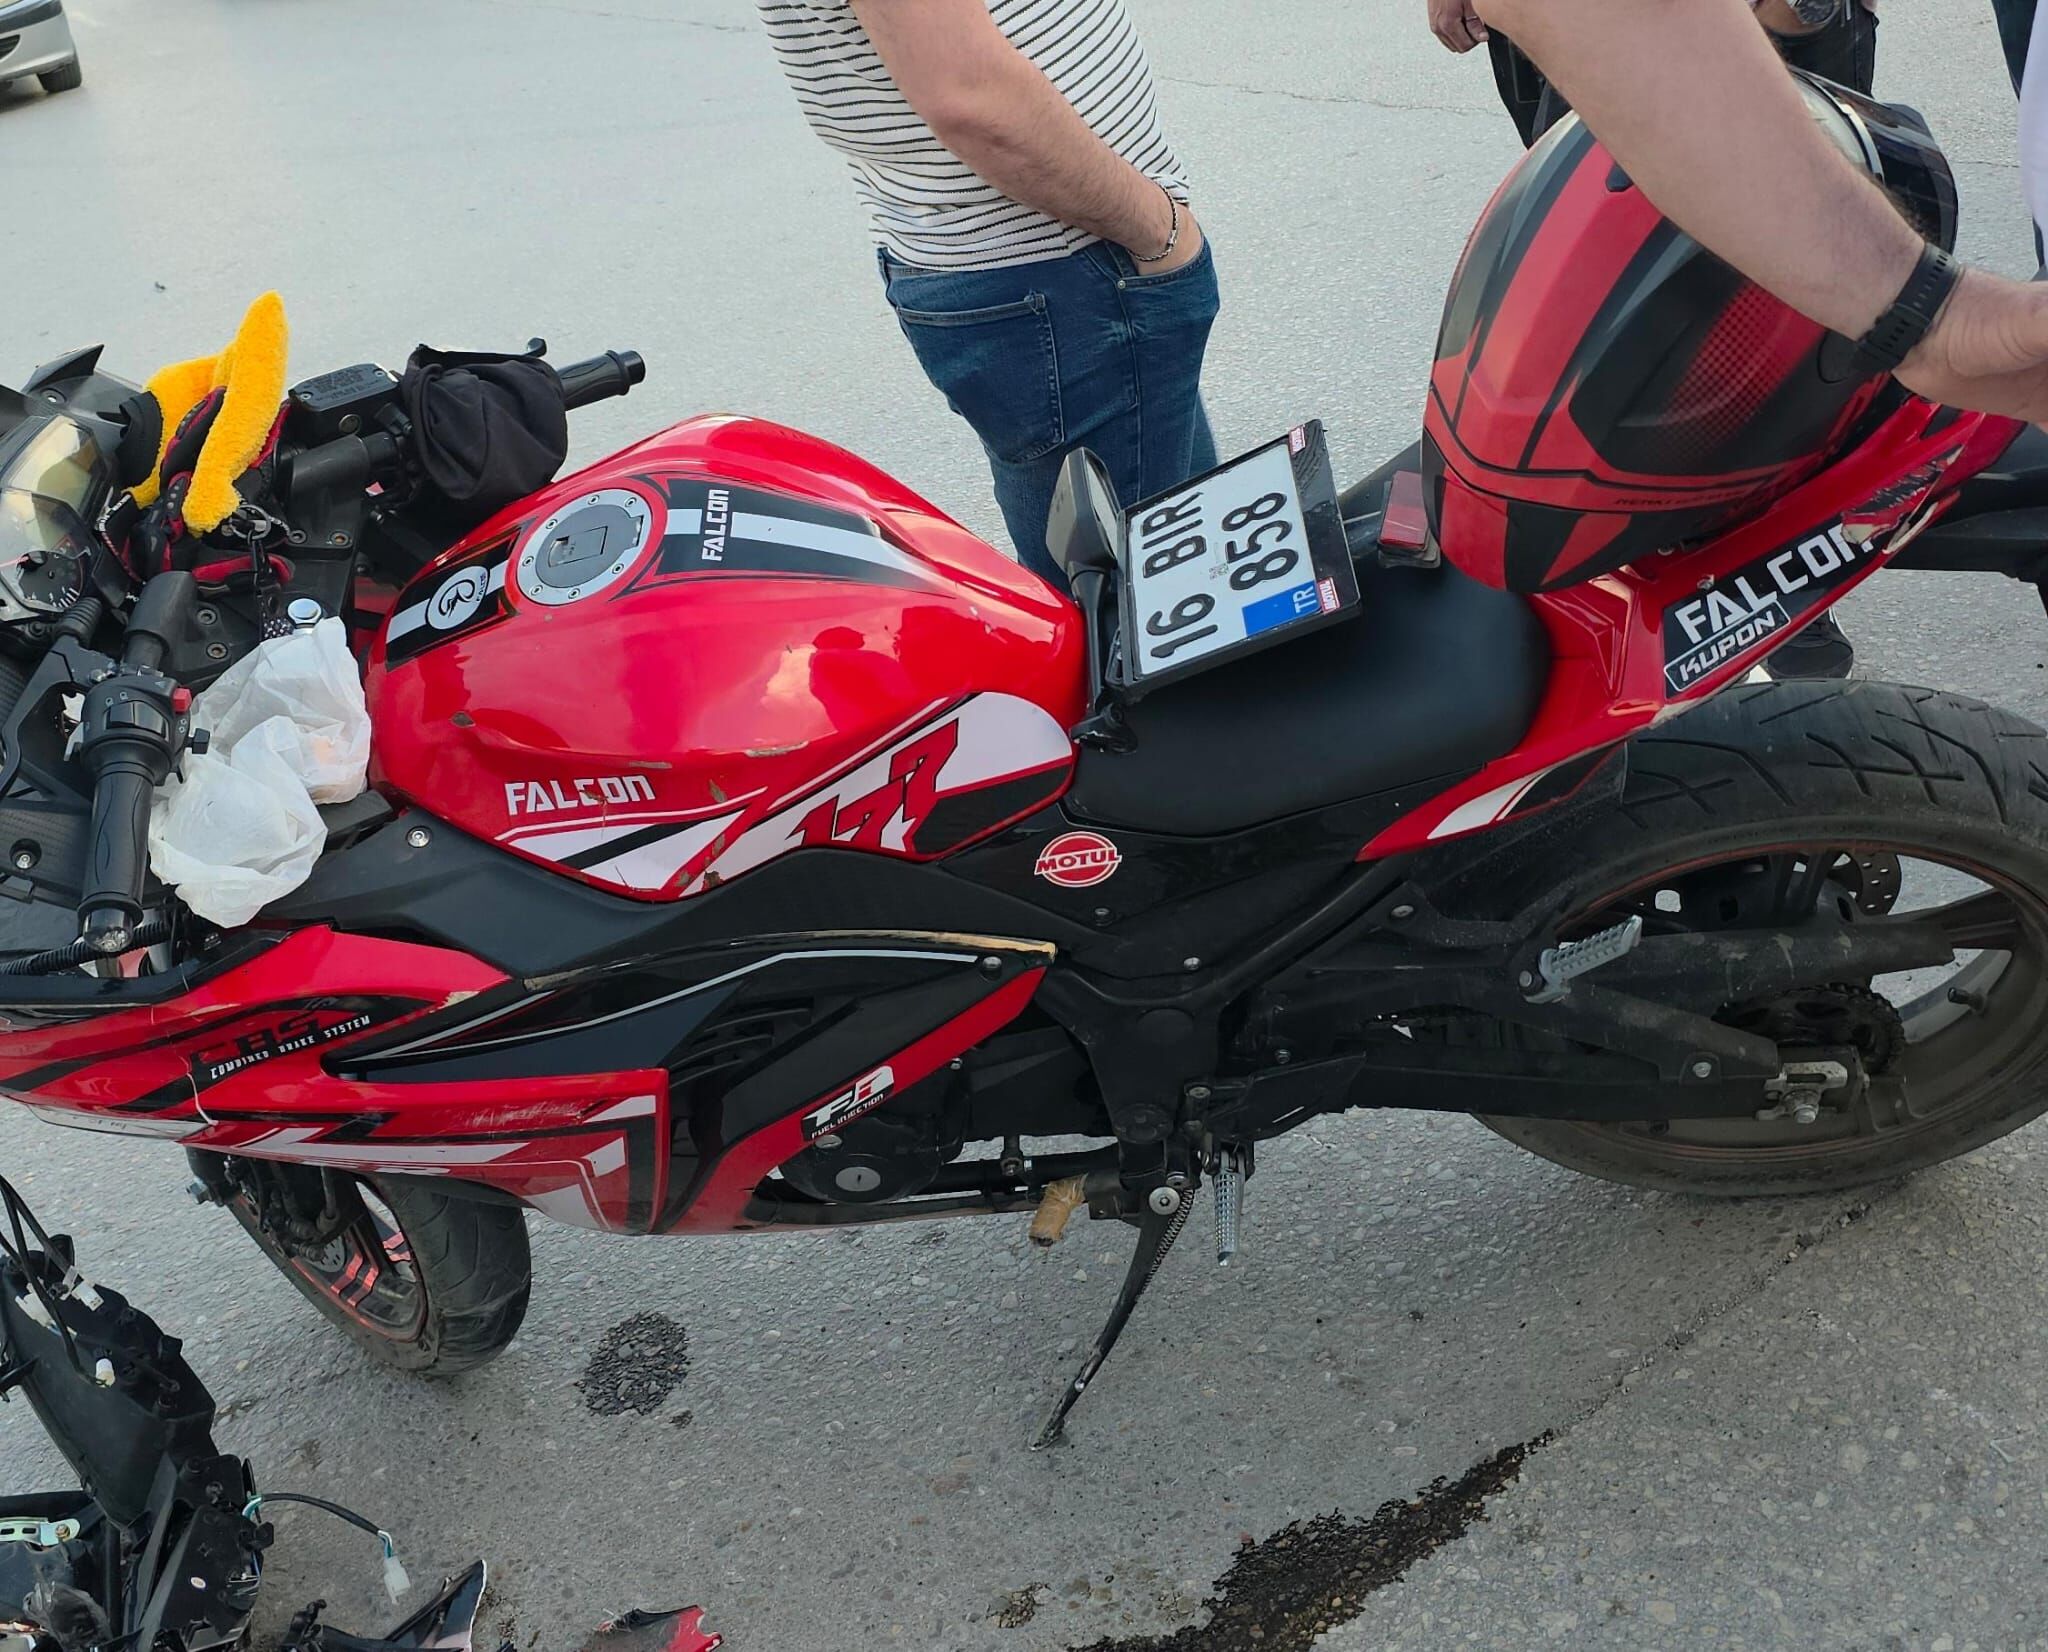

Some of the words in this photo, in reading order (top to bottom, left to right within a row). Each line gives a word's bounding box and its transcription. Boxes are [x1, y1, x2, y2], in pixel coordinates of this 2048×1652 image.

[702, 489, 729, 561] FALCON
[1140, 492, 1207, 578] BIR
[1222, 492, 1299, 590] 858
[1146, 593, 1218, 658] 16
[1293, 585, 1316, 614] TR
[1680, 610, 1776, 682] KUPON
[504, 774, 656, 816] FALCON
[1036, 847, 1118, 873] MOTUL
[323, 1014, 371, 1039] SYSTEM
[811, 1121, 836, 1140] FUEL
[837, 1092, 884, 1125] INJECTION
